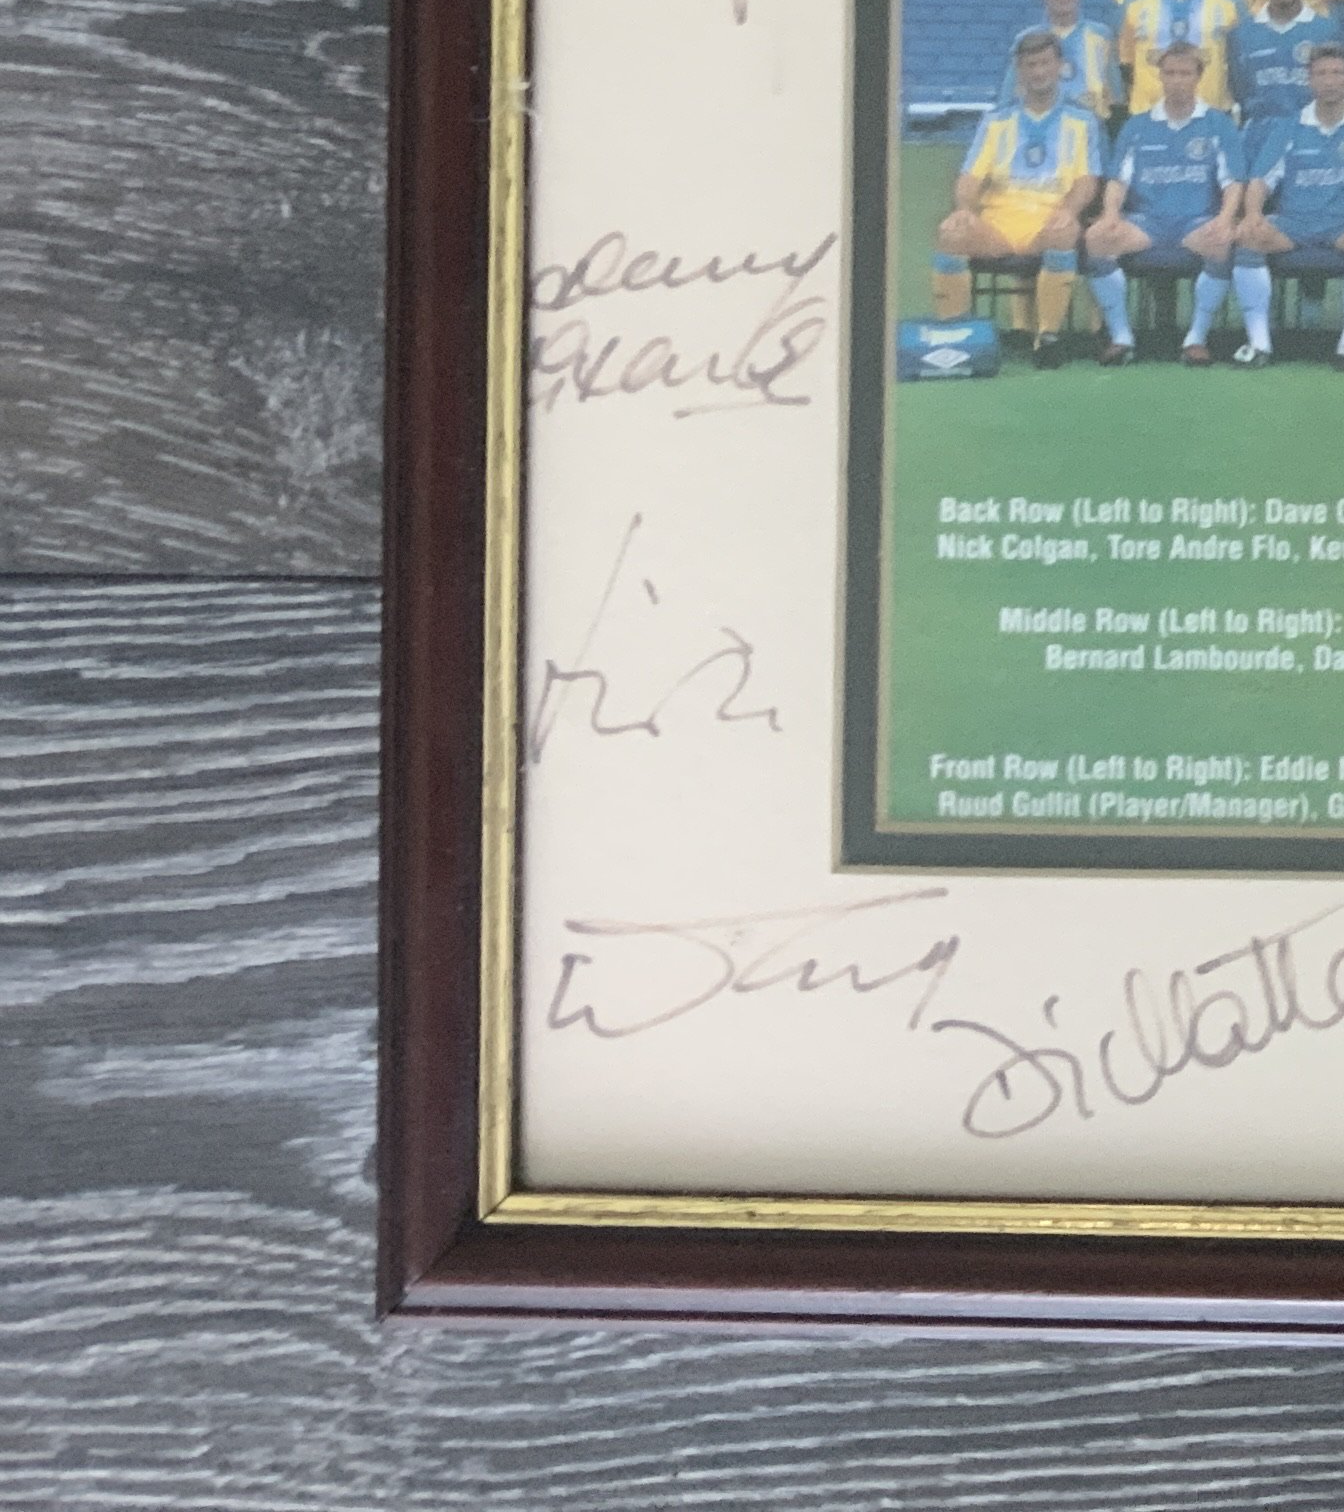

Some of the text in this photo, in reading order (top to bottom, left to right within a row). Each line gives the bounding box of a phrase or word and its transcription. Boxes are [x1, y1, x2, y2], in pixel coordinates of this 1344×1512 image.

[939, 497, 1000, 523] Back
[1008, 497, 1064, 523] Row
[1072, 498, 1131, 529] (Left
[1138, 498, 1163, 524] to
[1265, 498, 1328, 525] Dave
[937, 534, 993, 560] Nick
[1000, 534, 1097, 568] Colgan,
[1106, 535, 1161, 561] Tore
[1169, 535, 1243, 561] Andre
[1251, 535, 1298, 567] Flo,
[999, 607, 1087, 634] Middle
[1095, 608, 1150, 635] Row
[1158, 608, 1217, 640] (Left
[1225, 609, 1249, 635] to
[1045, 644, 1145, 671] Bernard
[930, 754, 996, 780] Front
[1003, 754, 1059, 780] Row
[1066, 755, 1126, 786] (Left
[1133, 755, 1158, 781] to
[1260, 755, 1330, 782] Eddie
[938, 791, 1004, 818] Ruud
[1011, 791, 1081, 819] Gullit
[1088, 792, 1317, 824] (Player/Manager),
